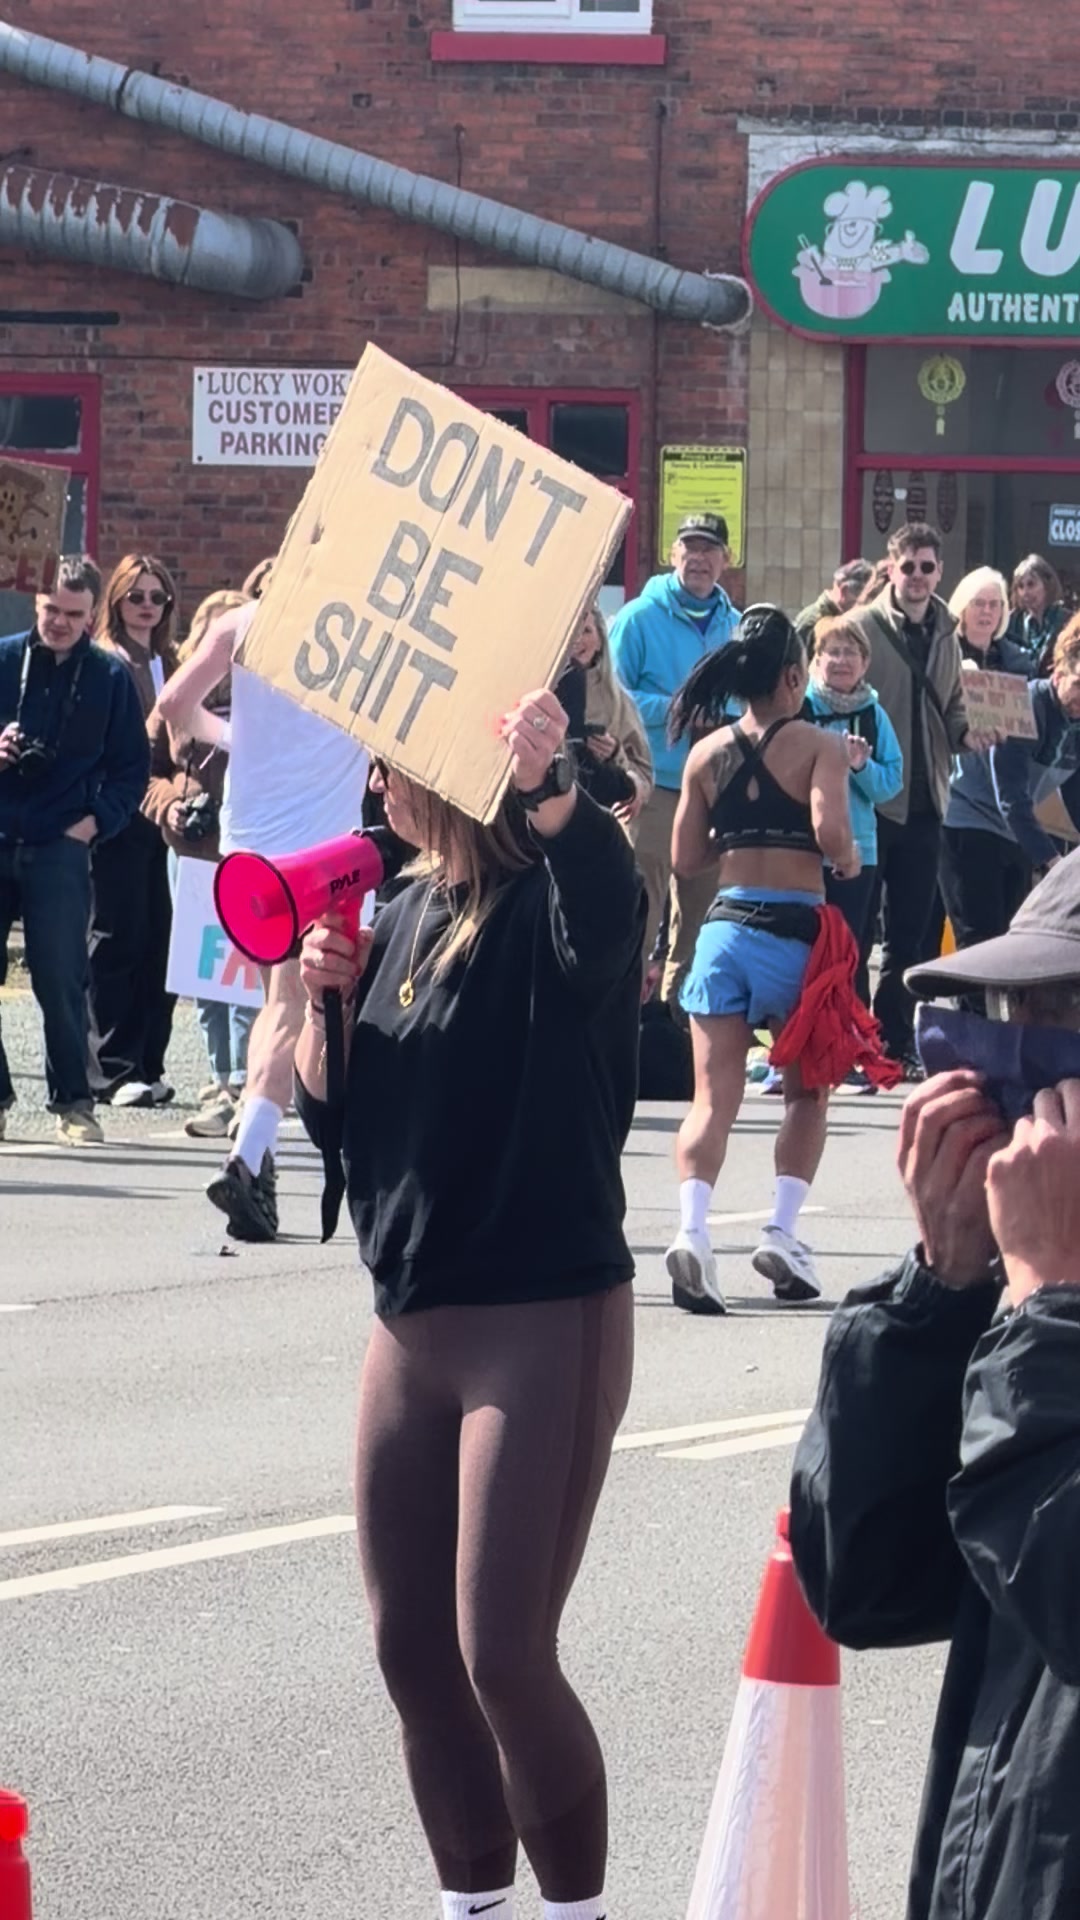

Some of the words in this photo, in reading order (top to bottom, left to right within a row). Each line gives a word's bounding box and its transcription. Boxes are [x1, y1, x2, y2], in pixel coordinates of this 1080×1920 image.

[950, 178, 1080, 277] LU
[948, 292, 1079, 323] AUTHENT
[207, 372, 285, 395] LUCKY
[292, 373, 352, 396] WOK
[370, 397, 587, 567] DON'T
[366, 520, 484, 653] BE
[294, 602, 458, 745] SHIT
[330, 869, 360, 894] PYLE
[198, 924, 263, 991] FA
